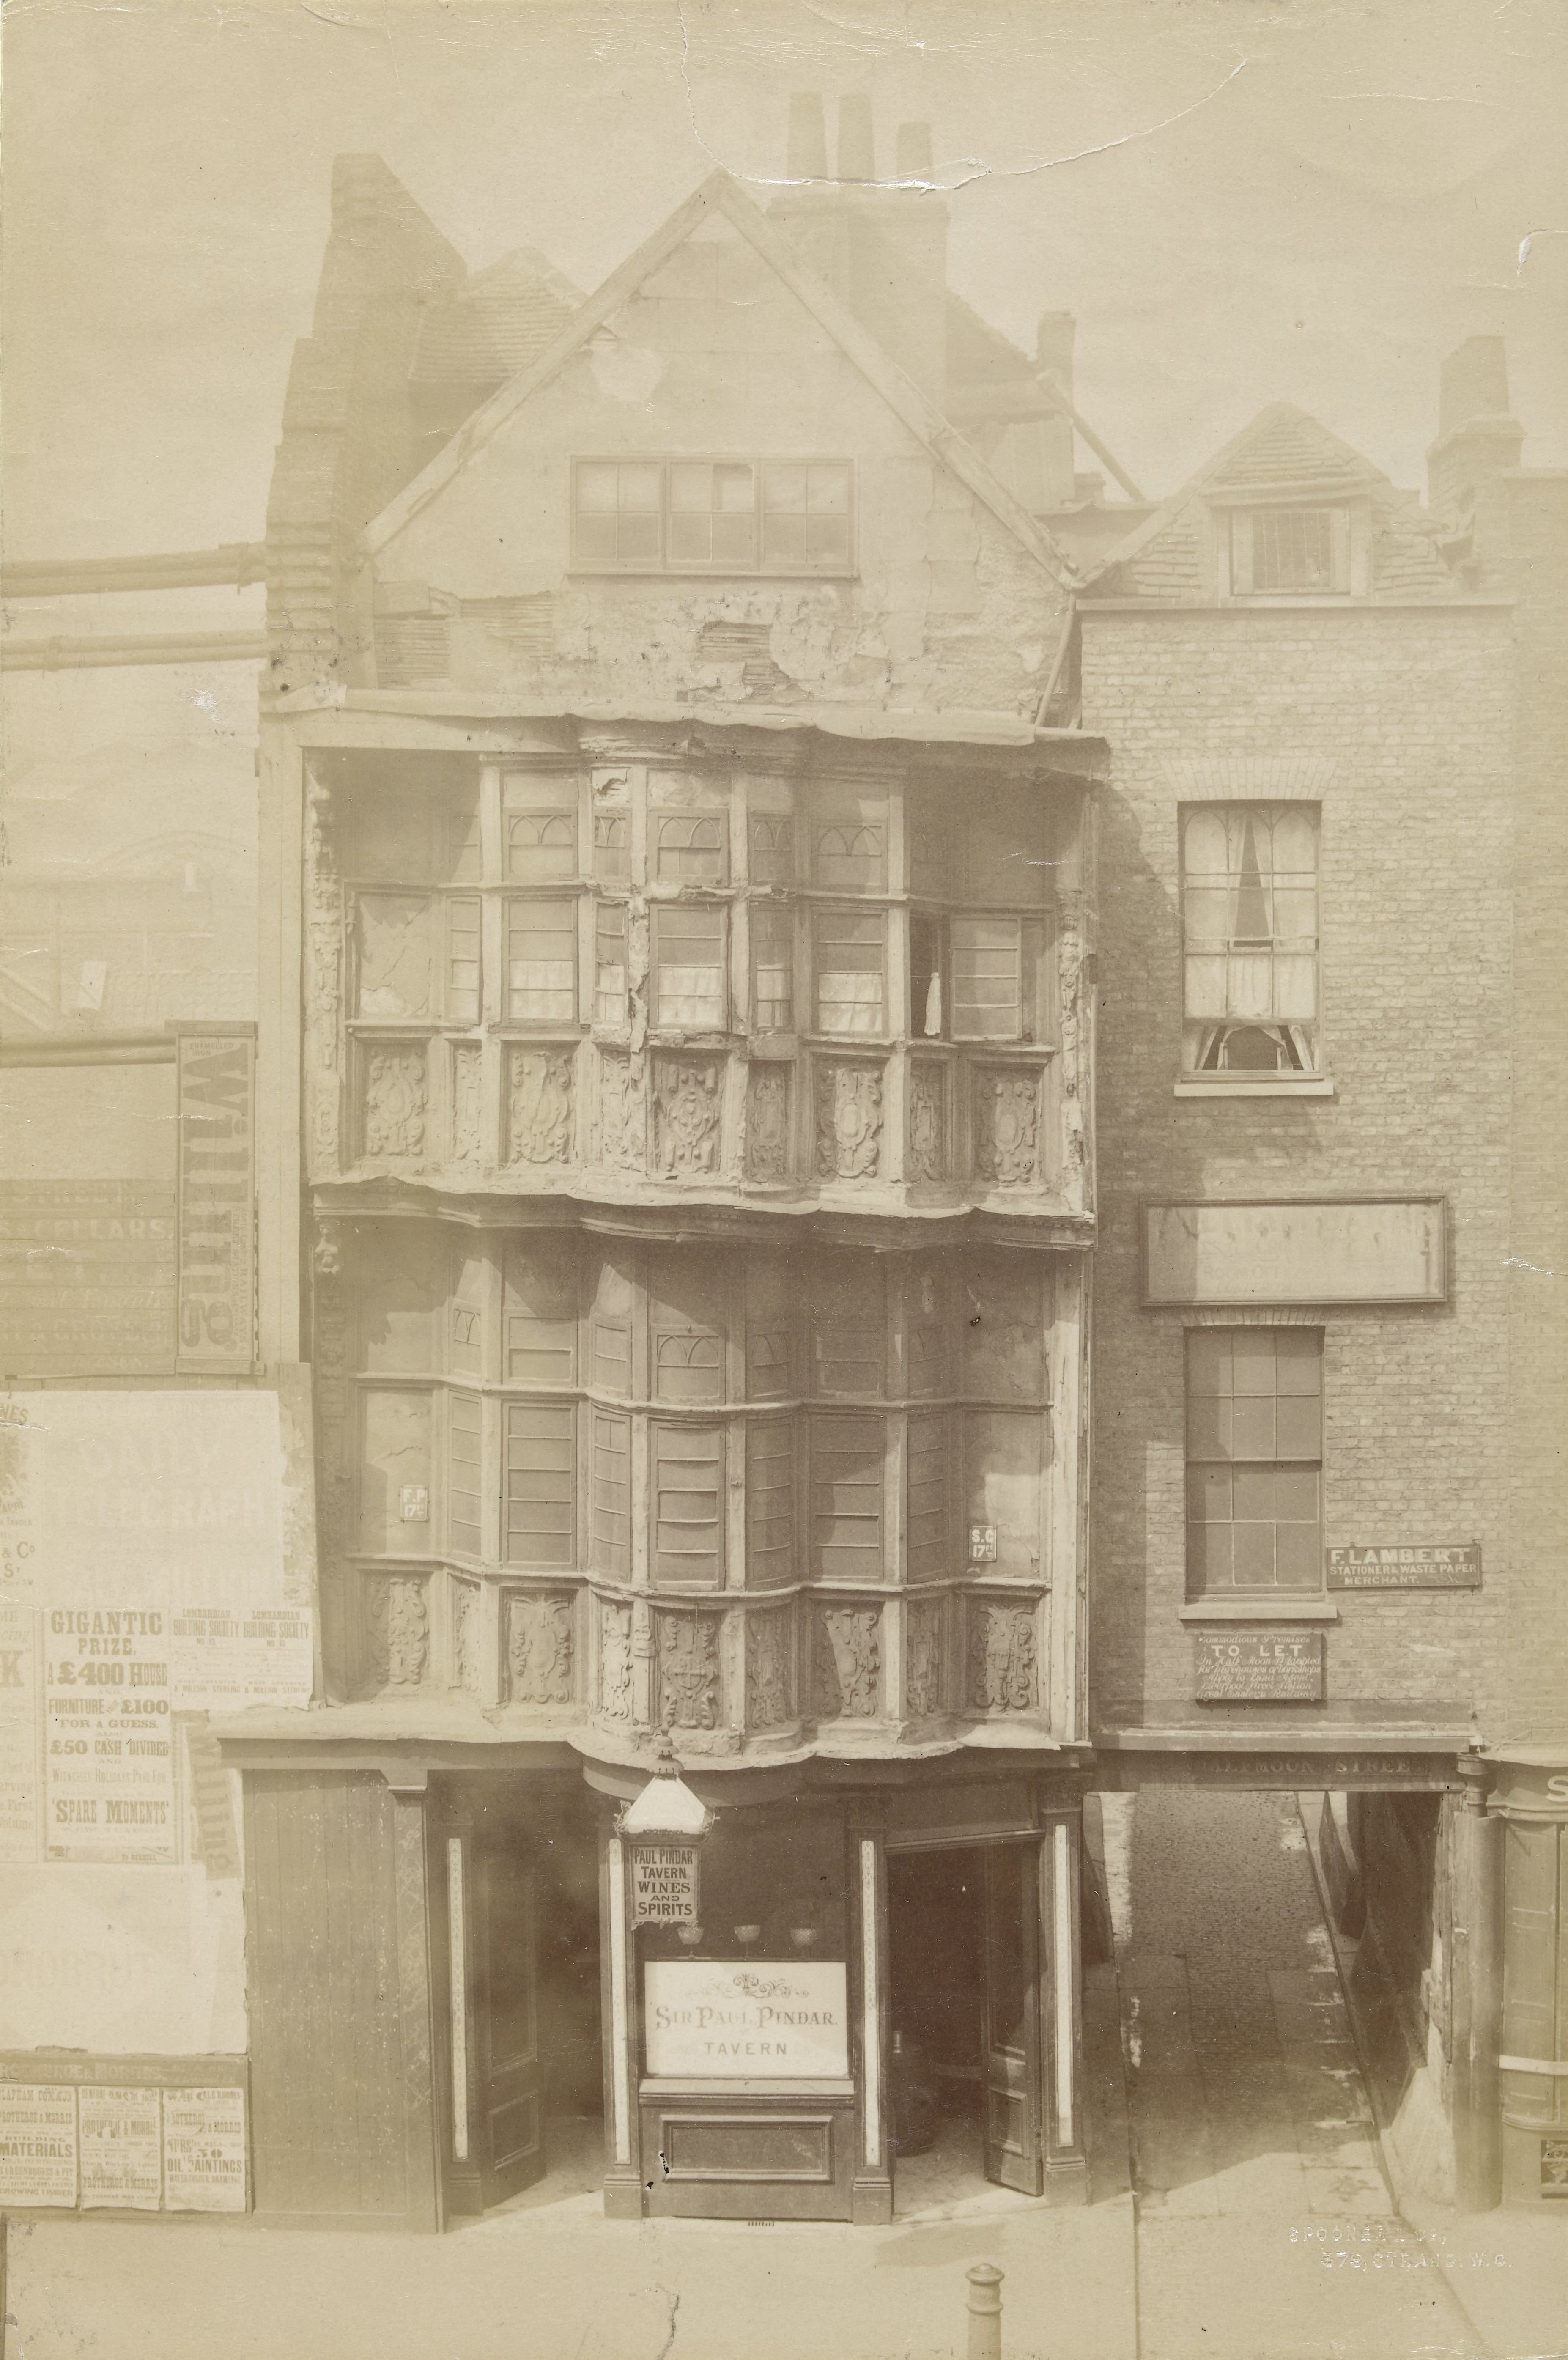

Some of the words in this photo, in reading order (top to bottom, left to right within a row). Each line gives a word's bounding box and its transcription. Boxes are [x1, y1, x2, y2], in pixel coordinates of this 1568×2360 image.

[181, 1043, 249, 1352] Willing
[2, 1547, 12, 1558] &
[1331, 1549, 1345, 1564] F.
[1349, 1547, 1471, 1564] LAMBERT
[1330, 1565, 1390, 1575] STATIONER
[1391, 1566, 1399, 1575] &
[1400, 1564, 1438, 1574] WASTE
[1439, 1564, 1477, 1574] PAPER
[1344, 1575, 1420, 1585] MERCHANT.
[182, 1608, 231, 1619] LOMBARDIAN
[252, 1610, 300, 1620] LOMBARDIAN
[51, 1610, 162, 1635] GIGANTIC
[173, 1619, 206, 1636] BUILDING
[209, 1620, 239, 1638] SOCIETY
[243, 1621, 276, 1638] BUILDING
[279, 1622, 309, 1639] SOCIETY
[1261, 1634, 1310, 1644] Premises
[1211, 1645, 1240, 1657] TO
[1259, 1645, 1302, 1657] LET
[1196, 1653, 1212, 1666] In
[1242, 1655, 1272, 1666] Moon
[47, 1662, 54, 1685] A
[57, 1661, 124, 1686] £400
[129, 1663, 168, 1686] HOUSE
[1196, 1665, 1213, 1676] for
[1201, 1681, 1244, 1691] Liverpool
[1227, 1689, 1266, 1699] Eastern
[49, 1698, 105, 1714] FURNITURE
[121, 1698, 169, 1715] £100
[60, 1719, 90, 1728] FOR
[50, 1739, 88, 1755] £50
[94, 1740, 122, 1756] CASH
[1254, 1758, 1315, 1773] MOON
[1335, 1757, 1414, 1773] STREE
[634, 1848, 657, 1865] PAUL
[659, 1848, 693, 1865] PINDAR
[641, 1866, 686, 1879] TAVERN
[637, 1881, 691, 1894] WINES
[638, 1902, 693, 1916] SPIRITS
[655, 2006, 691, 2029] SIR
[704, 2042, 787, 2055] TAVERN
[0, 2088, 34, 2101] LAPHAM
[45, 2112, 73, 2124] MORRIS
[214, 2121, 241, 2133] MORRIS
[0, 2143, 73, 2157] MATERIALS
[41, 2189, 73, 2197] TIMBER
